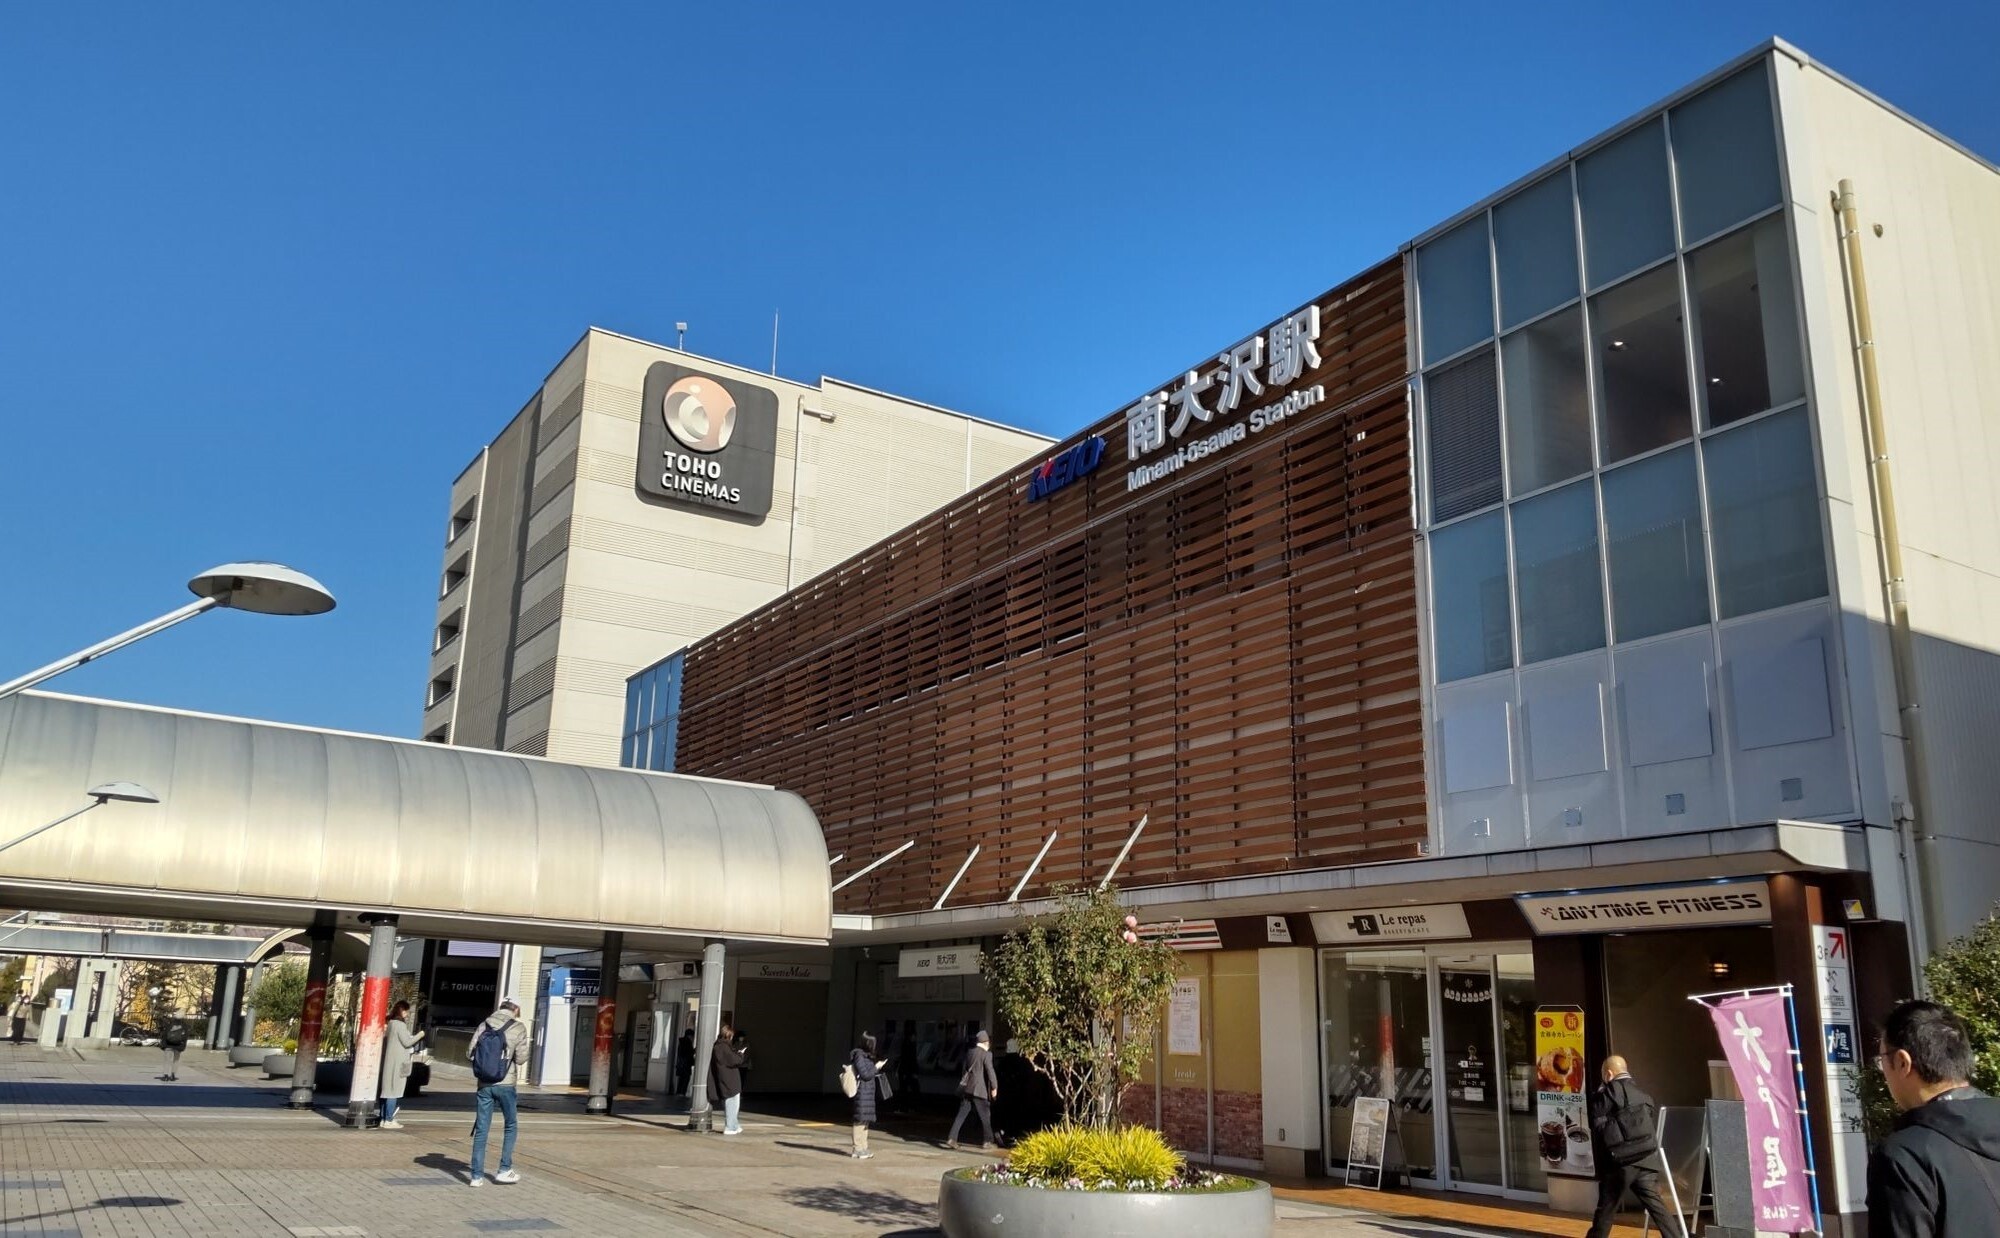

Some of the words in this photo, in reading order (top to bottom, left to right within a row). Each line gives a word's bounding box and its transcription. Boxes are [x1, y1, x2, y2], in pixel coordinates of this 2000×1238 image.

[1125, 305, 1322, 461] 南大沢駅
[1250, 384, 1325, 433] Station
[663, 451, 721, 479] TOHO
[1027, 435, 1107, 503] KEIO
[661, 473, 741, 502] CINEMAS
[1379, 914, 1395, 926] Le
[1398, 913, 1426, 926] repas
[1558, 901, 1654, 921] ANYTIME
[1656, 893, 1763, 915] FITNESS
[1361, 918, 1370, 931] R
[1817, 945, 1828, 960] 3F
[452, 983, 474, 991] TOHO
[1540, 1093, 1564, 1102] DRINK
